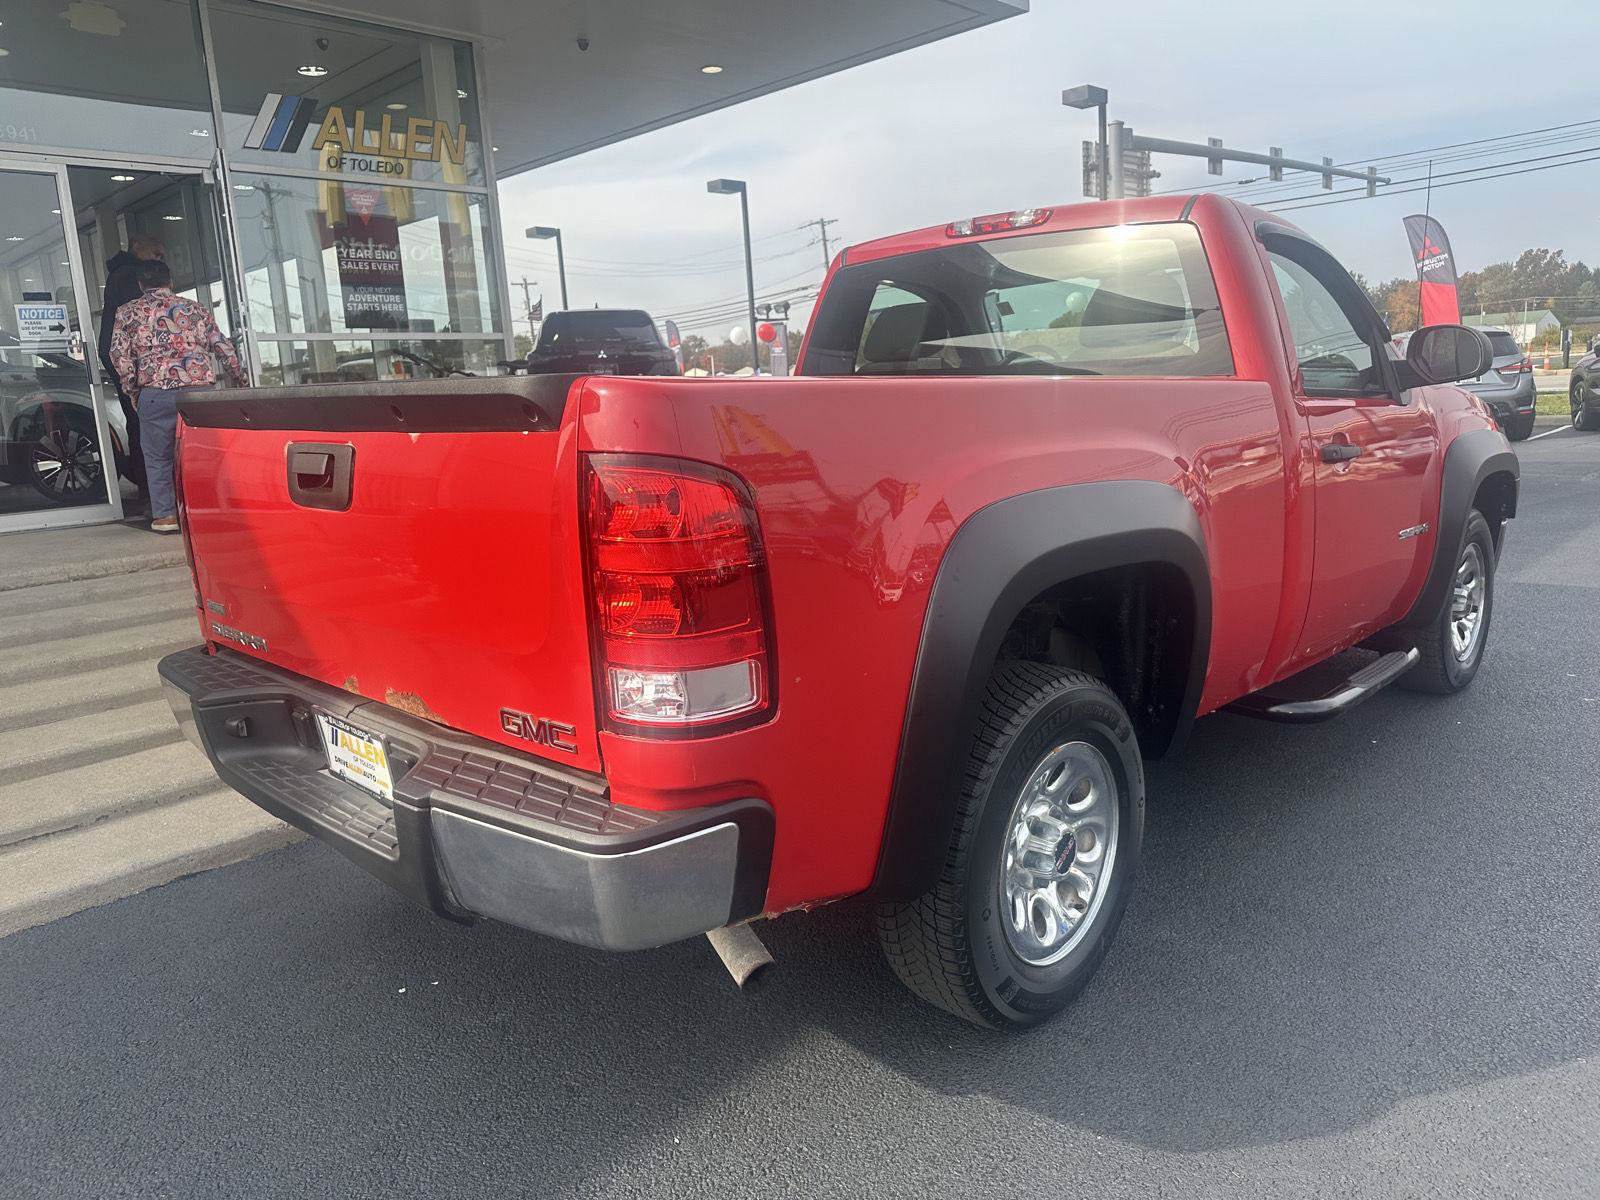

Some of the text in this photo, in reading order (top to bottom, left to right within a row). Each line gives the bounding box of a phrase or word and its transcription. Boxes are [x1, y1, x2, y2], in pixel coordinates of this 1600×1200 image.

[312, 106, 467, 164] ALLEN
[328, 155, 404, 175] OF TOLEDO
[340, 248, 397, 260] YEAR END
[341, 261, 400, 271] SALES EVENT
[348, 294, 401, 303] ADVENTURE
[346, 303, 405, 312] STARTS HERE
[22, 309, 62, 319] NOTICE
[499, 706, 578, 755] GMC
[340, 731, 386, 768] ALLEN
